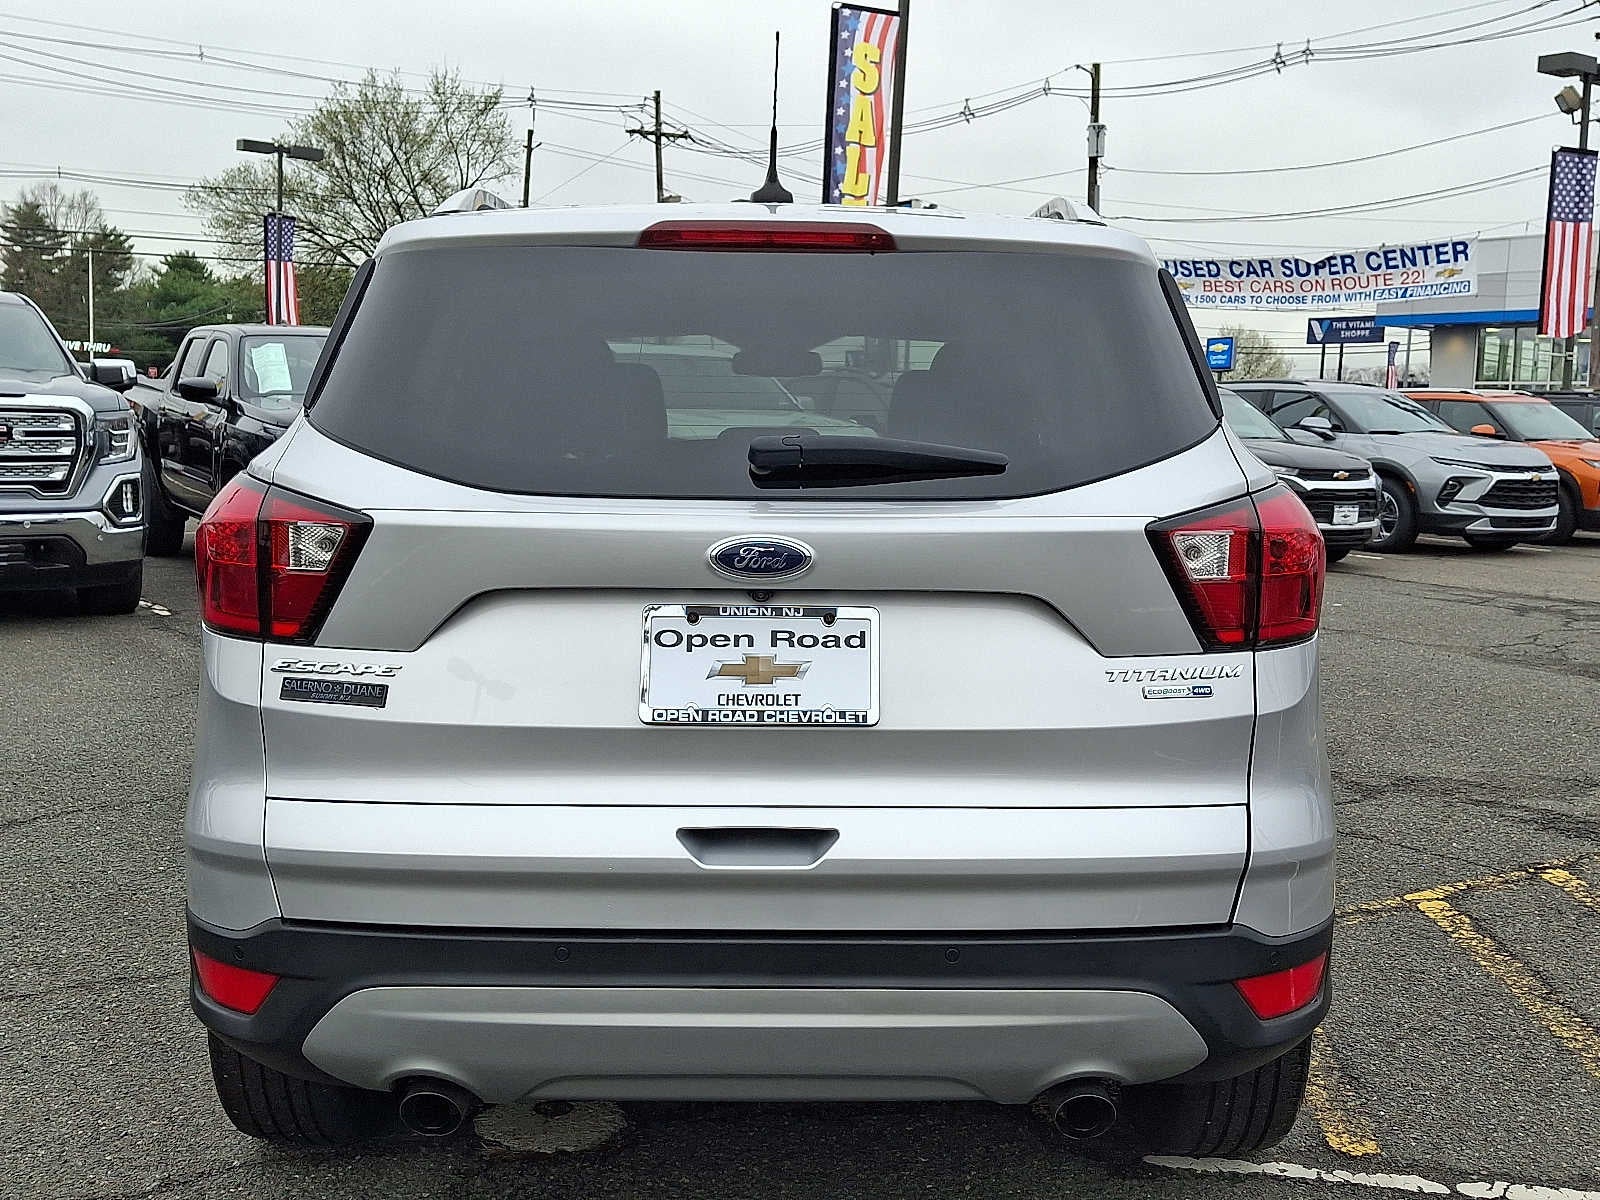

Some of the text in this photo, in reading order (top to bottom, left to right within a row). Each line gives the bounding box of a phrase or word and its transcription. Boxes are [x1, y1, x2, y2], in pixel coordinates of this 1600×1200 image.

[841, 41, 881, 206] SAL
[1164, 240, 1469, 279] USED CAR SUPER CENTER
[1203, 268, 1426, 294] BEST CARS ON ROUTE 22!
[1195, 295, 1217, 304] 1500
[1220, 295, 1247, 305] CARS
[1250, 295, 1262, 305] TO
[1266, 295, 1308, 305] CHOOSE
[1311, 293, 1341, 304] FROM
[1344, 290, 1372, 302] WITH
[1374, 287, 1406, 300] EASY
[1406, 281, 1469, 297] FINANCING
[1332, 320, 1377, 330] THE VITAMI
[83, 341, 112, 353] THRU
[734, 546, 788, 569] Ford
[719, 606, 804, 617] UNION, NJ
[653, 629, 866, 652] Open Road
[270, 658, 403, 677] ESCAPE
[1105, 664, 1244, 682] TITANIUM
[283, 679, 384, 697] SALERNO DUANE
[1193, 686, 1211, 694] 4WD
[717, 693, 801, 707] CHEVROLET
[653, 710, 867, 723] OPEN ROAD CHEVROLET
